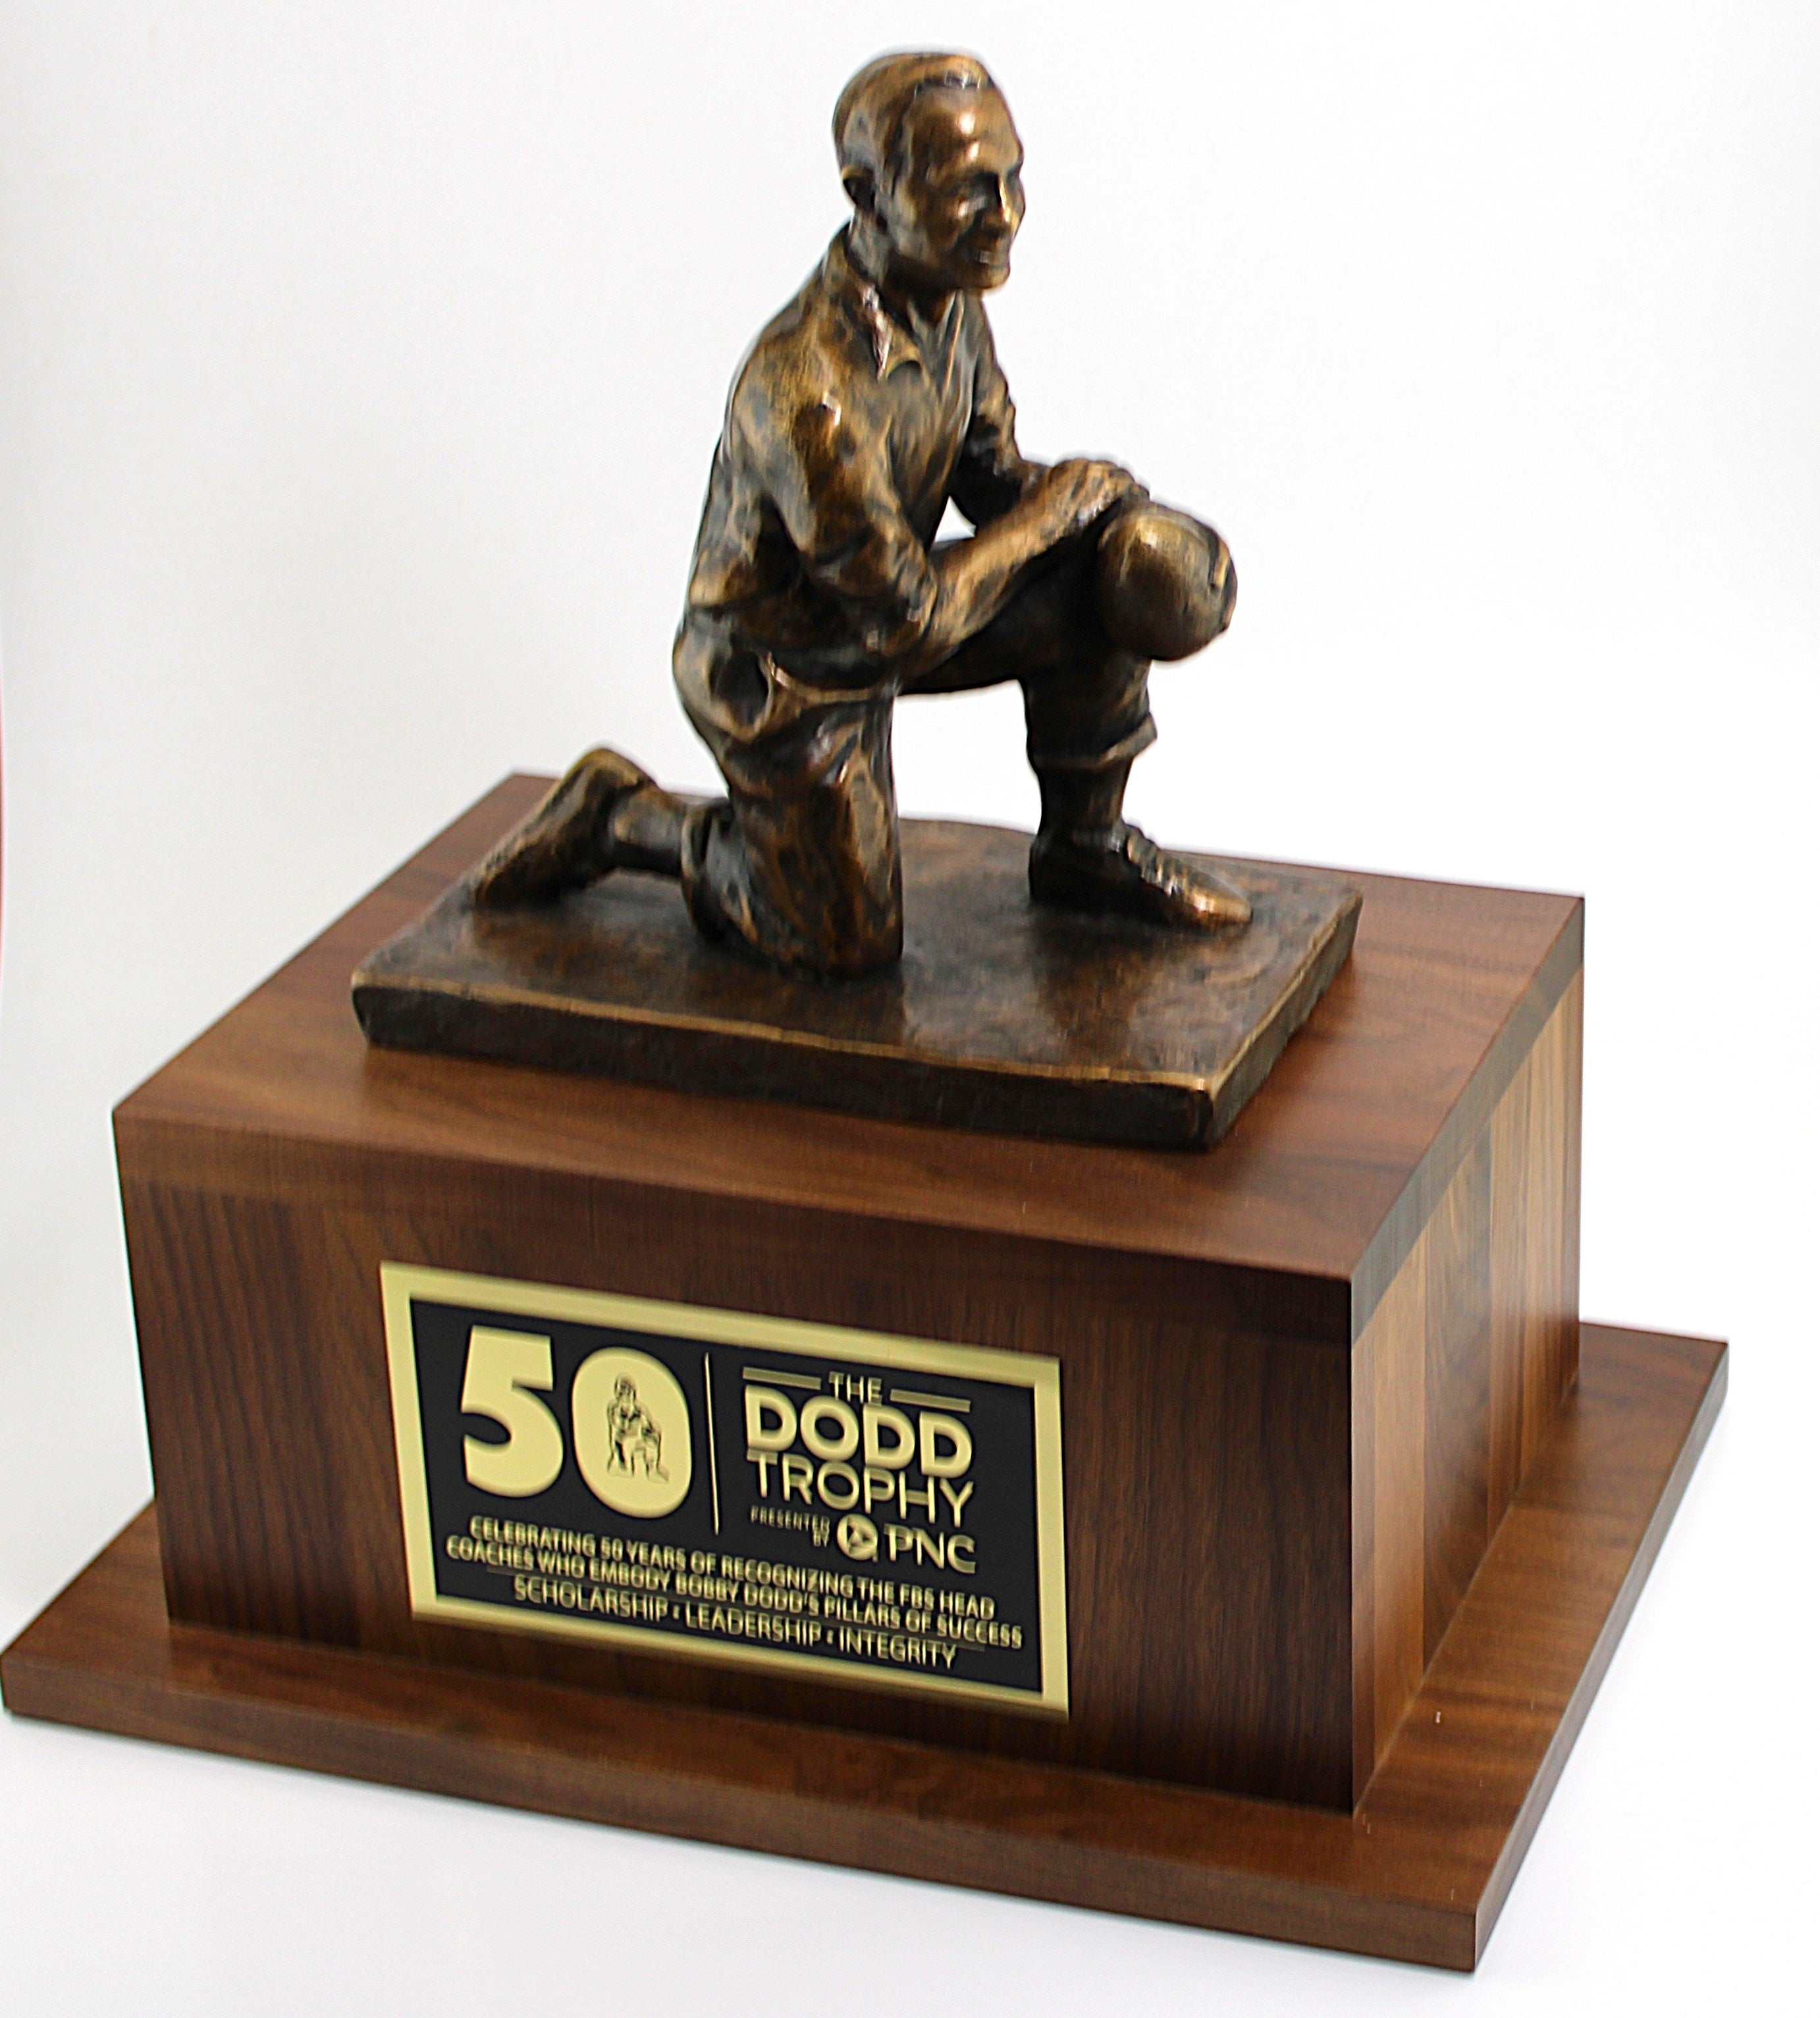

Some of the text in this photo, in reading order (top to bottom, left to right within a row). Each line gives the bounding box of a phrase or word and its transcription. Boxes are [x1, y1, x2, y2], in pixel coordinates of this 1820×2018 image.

[461, 1325, 693, 1519] 50
[828, 1371, 882, 1405] THE
[745, 1385, 973, 1479] DODD
[747, 1448, 974, 1528] TROPHY
[750, 1505, 830, 1532] PRESENTED
[469, 1516, 995, 1620] CELEBRATING 50 YEARS OF RECOGNIZING THE FBS HEAD
[812, 1526, 830, 1547] BY
[884, 1522, 976, 1574] PNC
[446, 1535, 1023, 1649] COACHES WHO EMBODY BOBBY DODD'S PILLARS OF SUCCESS
[514, 1574, 957, 1670] SCHOLARSHIP LEADERSHIP INTEGRITY
